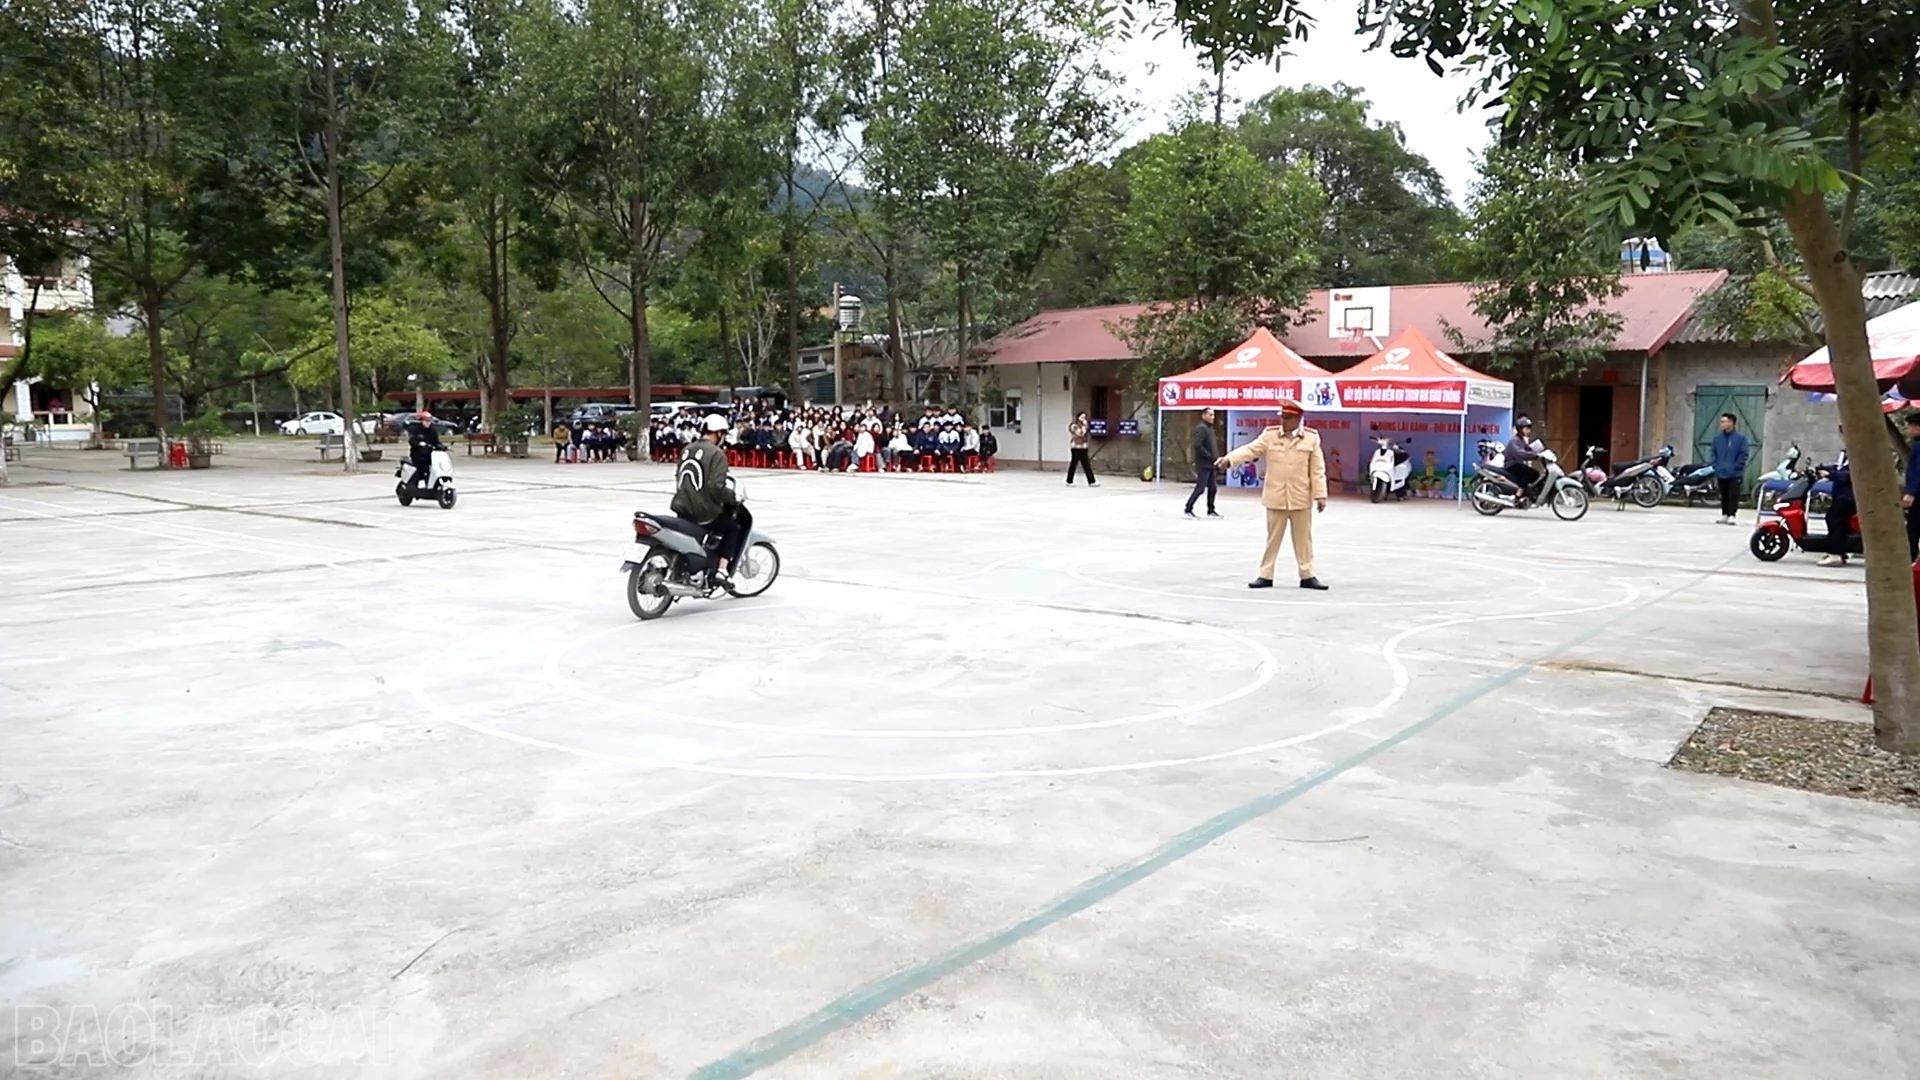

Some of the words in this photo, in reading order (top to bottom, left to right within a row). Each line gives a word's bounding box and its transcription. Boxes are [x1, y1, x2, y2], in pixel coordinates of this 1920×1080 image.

[1227, 387, 1238, 400] BIA
[1253, 386, 1274, 400] KHÔNG
[1274, 386, 1285, 400] LÁI
[1285, 388, 1294, 400] XE
[1354, 386, 1362, 403] ĐỘI
[1371, 384, 1381, 401] BẢO
[1382, 384, 1395, 401] HIỂM
[1395, 388, 1404, 401] KHI
[1405, 388, 1419, 402] THAM
[1429, 388, 1442, 403] GIAO
[1442, 387, 1461, 403] THÔNG
